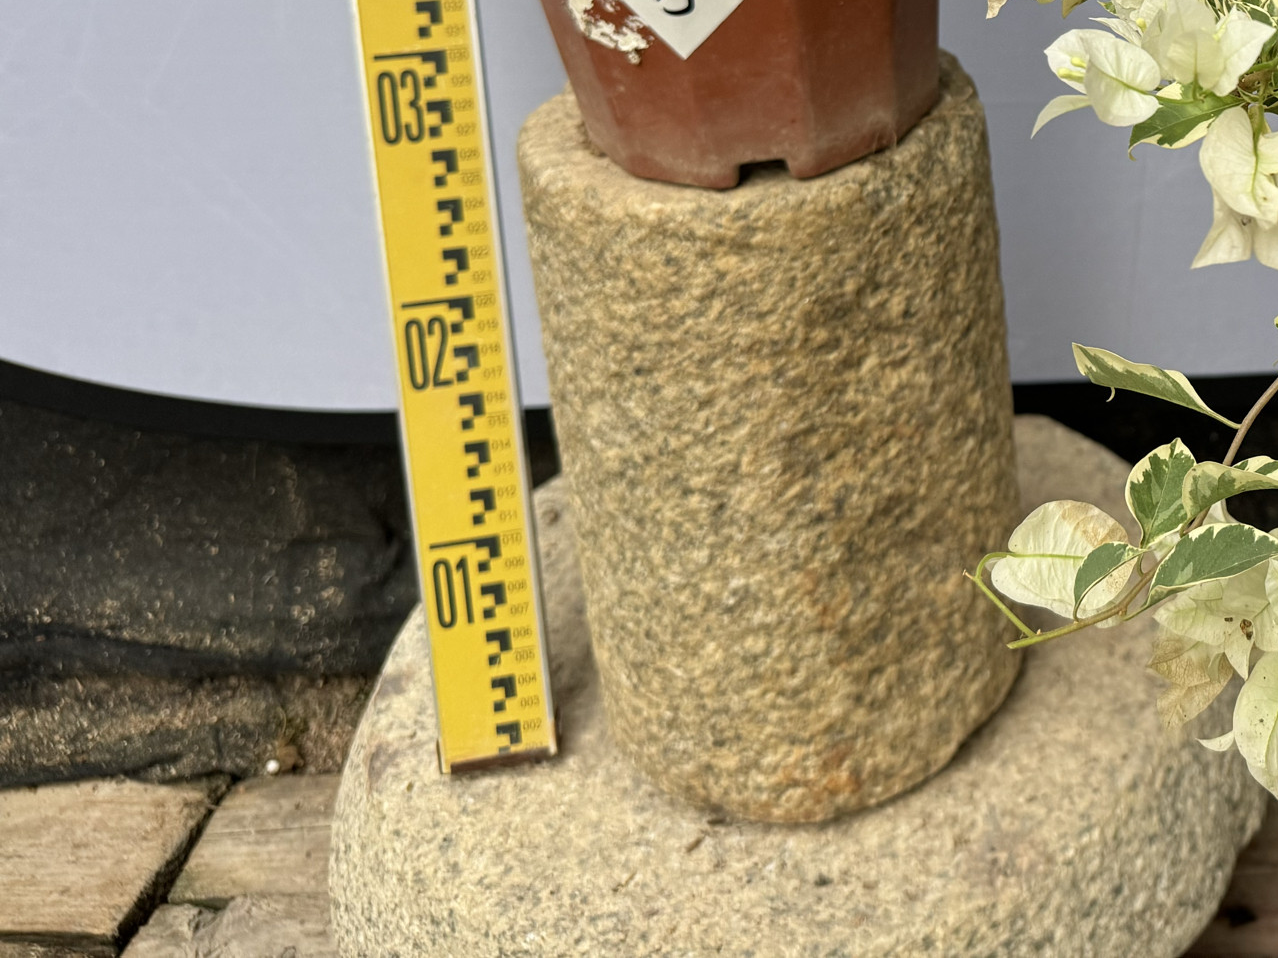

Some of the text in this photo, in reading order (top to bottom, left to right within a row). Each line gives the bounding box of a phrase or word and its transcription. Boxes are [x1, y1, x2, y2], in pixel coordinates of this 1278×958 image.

[378, 70, 424, 145] 03
[405, 315, 453, 391] 02
[433, 556, 474, 629] 01
